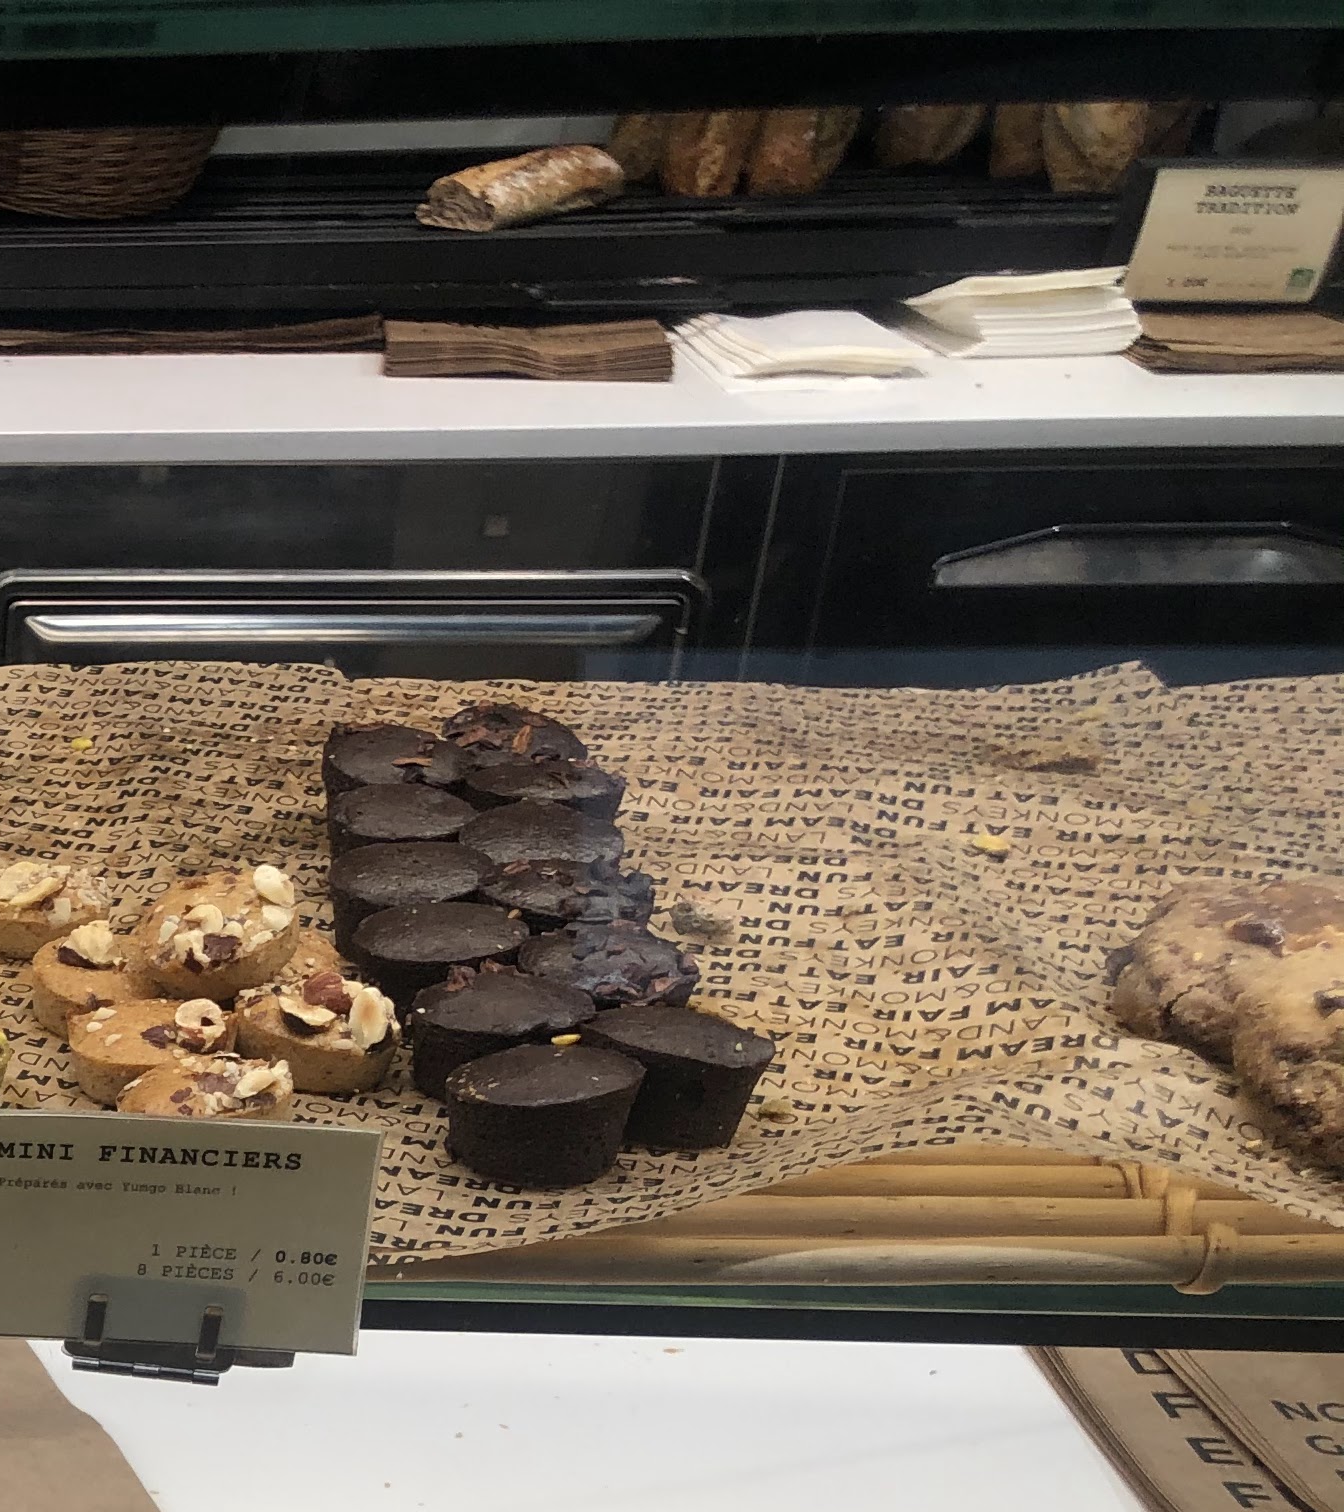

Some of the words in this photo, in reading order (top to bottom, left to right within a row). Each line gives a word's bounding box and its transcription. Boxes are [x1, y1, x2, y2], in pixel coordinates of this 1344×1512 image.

[98, 1143, 303, 1172] FINANCIERS
[151, 1243, 160, 1259] 1
[176, 1243, 237, 1262] PIÈCE
[274, 1249, 338, 1267] 0.80€
[137, 1264, 147, 1277] 8
[161, 1261, 234, 1282] PIÈCES
[273, 1269, 335, 1287] 6.00€
